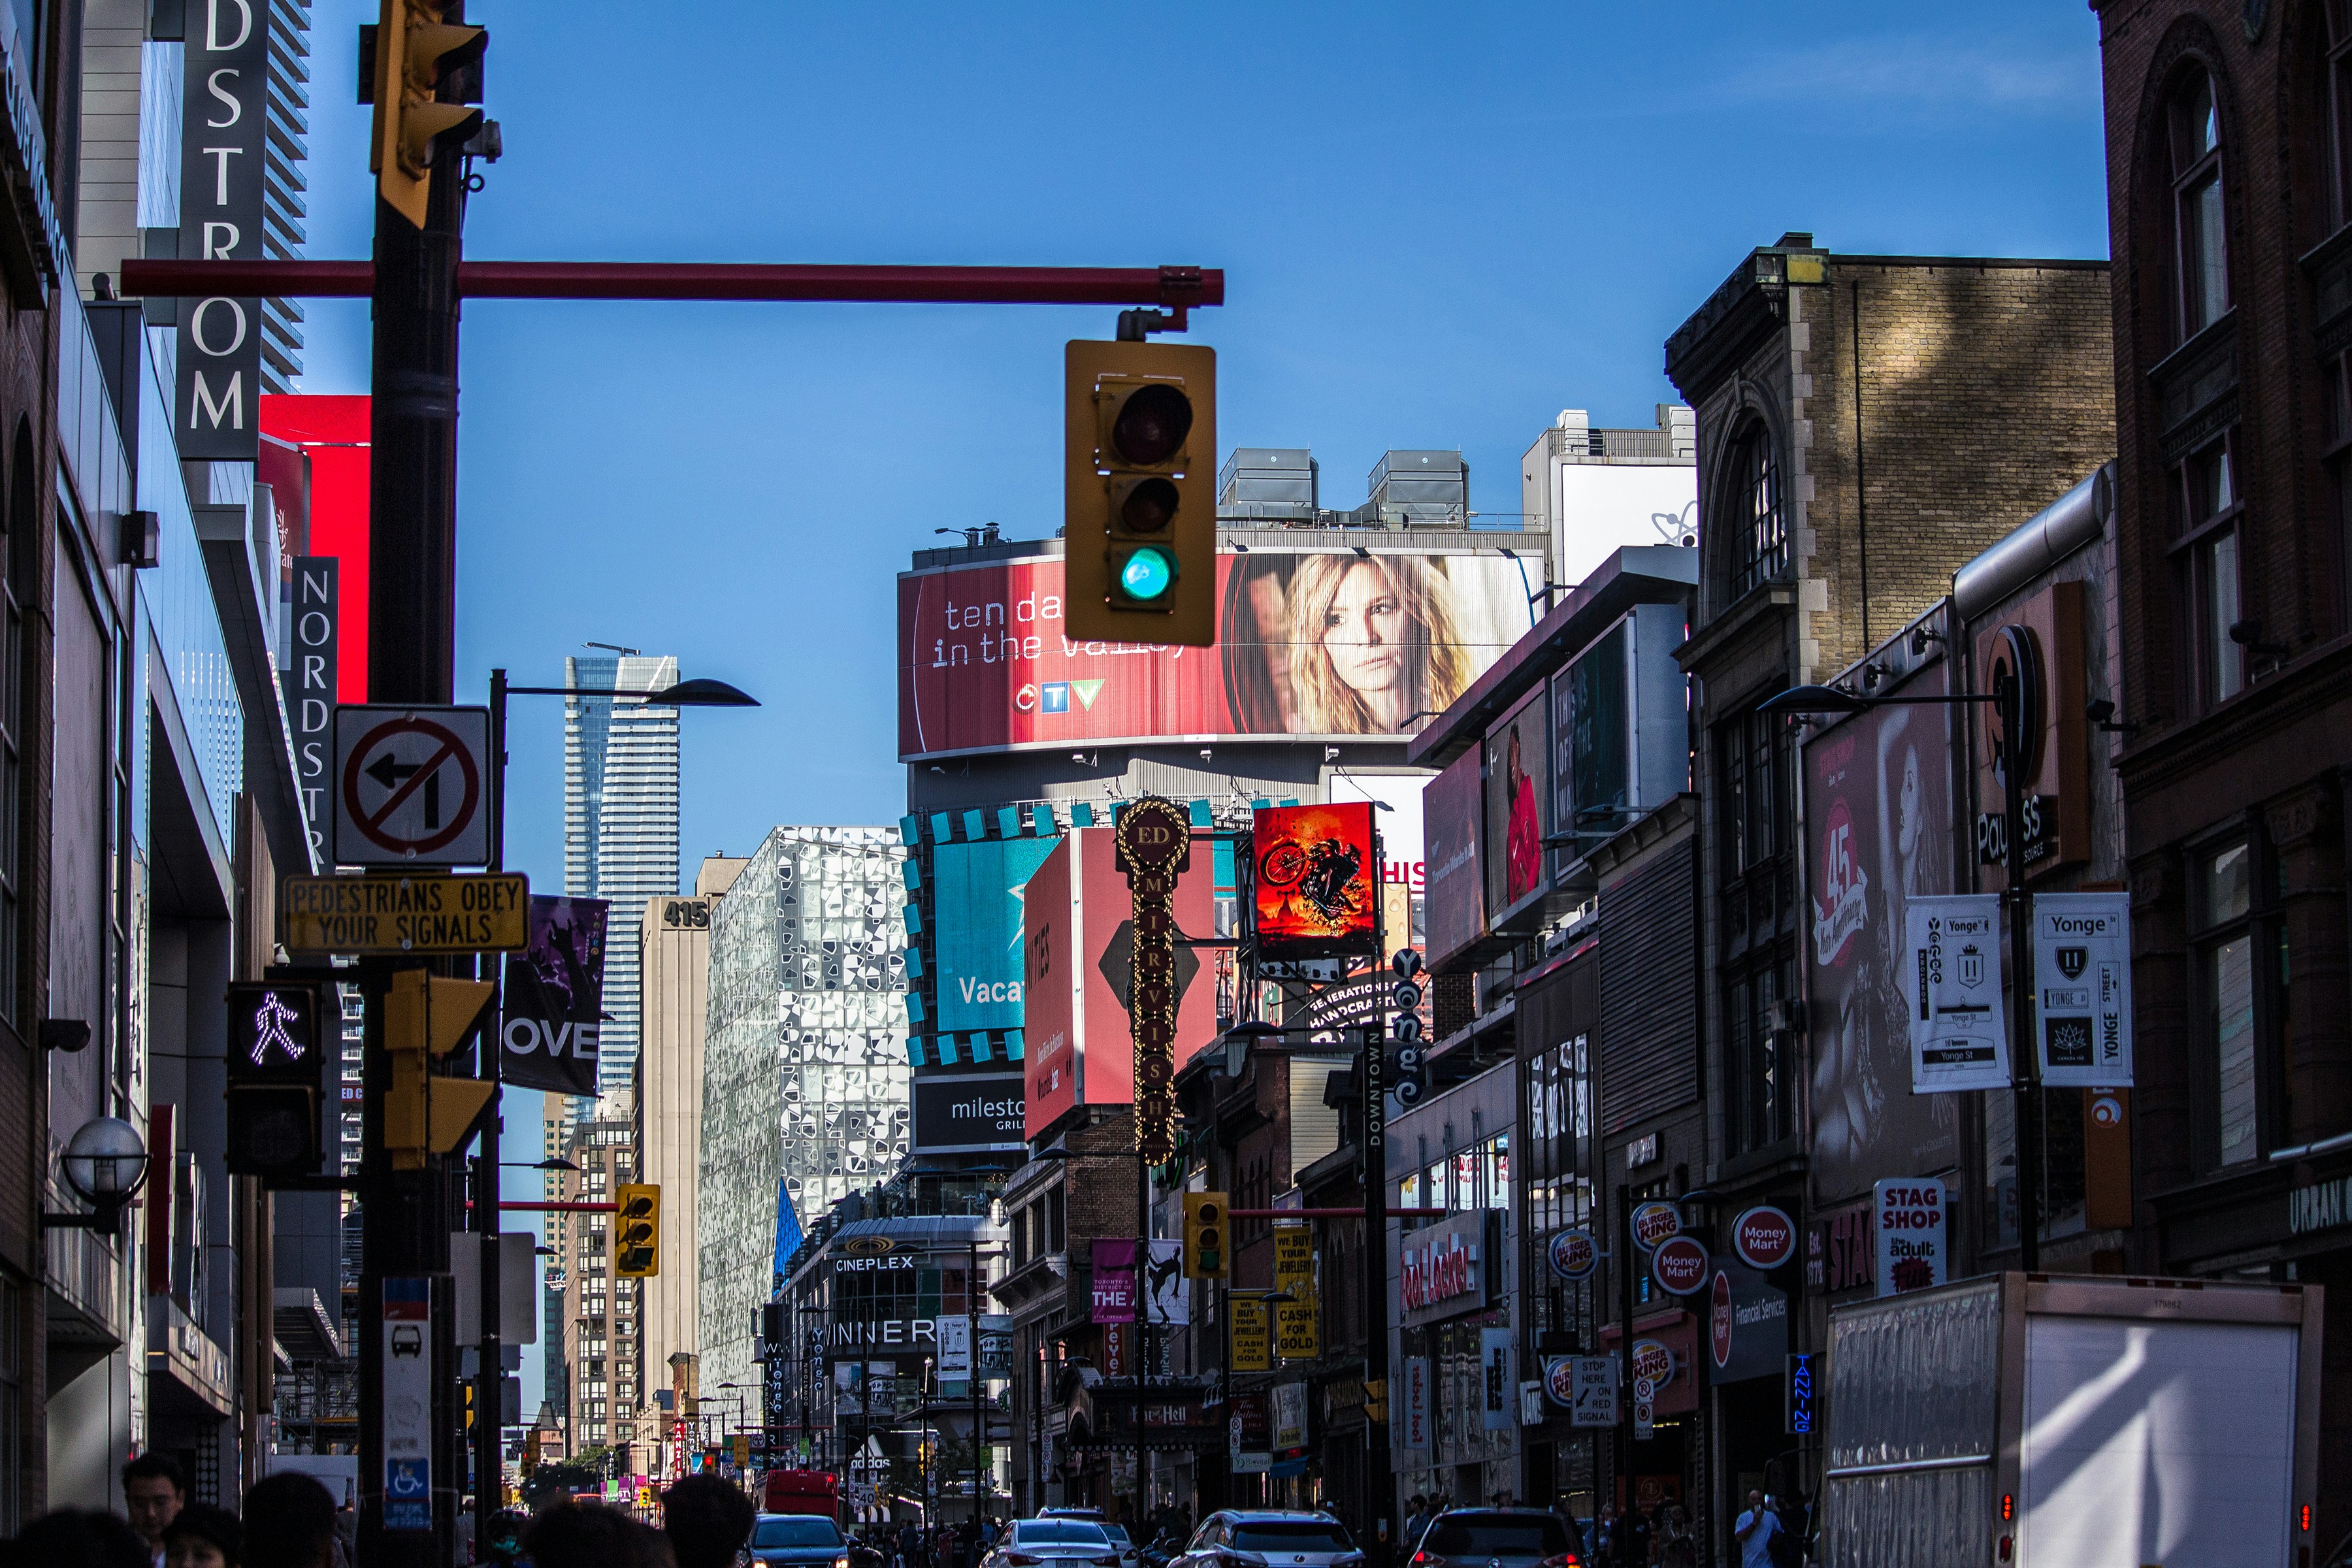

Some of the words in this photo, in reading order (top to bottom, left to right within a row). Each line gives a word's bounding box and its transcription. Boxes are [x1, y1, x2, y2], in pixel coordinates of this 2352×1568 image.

[945, 601, 1005, 630] ten
[933, 638, 968, 668] in
[980, 632, 1041, 663] the
[1016, 683, 1100, 712] CTV
[1137, 826, 1170, 845] ED
[1978, 794, 2041, 868] Payss
[1827, 823, 1850, 909] 45
[293, 883, 442, 914] PEDESTRIANS
[461, 881, 520, 913] OBEY
[664, 901, 709, 927] 415
[318, 917, 378, 945] YOUR
[396, 915, 491, 945] SIGNALS
[1949, 920, 1978, 934] Yonge
[2051, 917, 2106, 936] Yonge
[959, 977, 1021, 1004] Vaca
[2102, 968, 2111, 1002] STREET
[1145, 878, 1163, 1115] MIRVISH
[2051, 992, 2074, 1005] YONGE
[1309, 996, 1397, 1029] HANDCRATE
[1952, 1014, 1968, 1022] Yonge
[1394, 949, 1421, 1106] Yonge
[2104, 1012, 2118, 1060] YONGE
[1941, 1053, 1965, 1062] Yonge
[1369, 1032, 1380, 1146] DOWNTOWN
[1885, 1188, 1938, 1207] STAG
[2289, 1179, 2340, 1234] URBAN
[1638, 1211, 1675, 1230] BURGER
[1882, 1210, 1941, 1230] SHOP
[1639, 1219, 1677, 1241] KING
[1745, 1227, 1786, 1241] Money
[1278, 1237, 1290, 1247] WE
[1292, 1234, 1309, 1247] BUY
[1557, 1239, 1590, 1256] BURGER
[1750, 1237, 1779, 1250] Mart
[1890, 1241, 1935, 1256] adult
[1281, 1249, 1307, 1258] YOUR
[1558, 1247, 1592, 1269] KING
[1662, 1256, 1702, 1270] Money
[836, 1256, 914, 1273] CINEPLEX
[1278, 1259, 1311, 1274] JEWELLERY
[1426, 1233, 1469, 1305] Locker
[1667, 1266, 1695, 1277] Mart
[1400, 1248, 1424, 1312] Foot
[1092, 1291, 1127, 1307] THE
[1237, 1309, 1254, 1318] BUY
[1279, 1309, 1313, 1322] CASH
[1713, 1303, 1729, 1325] Money
[1735, 1302, 1761, 1326] Financial
[1762, 1298, 1786, 1322] Services
[1234, 1326, 1266, 1336] JEWELLERY
[1286, 1324, 1307, 1335] FOR
[1715, 1322, 1727, 1339] Mart
[1280, 1337, 1314, 1350] GOLD
[1582, 1362, 1606, 1371] STOP
[1633, 1350, 1666, 1367] BURGER
[1634, 1358, 1669, 1379] KING
[1582, 1374, 1607, 1384] HERE
[1598, 1388, 1611, 1396] ON
[1795, 1354, 1810, 1433] TANNING
[1592, 1399, 1611, 1409] RED
[1163, 1405, 1186, 1425] Hell
[1578, 1413, 1611, 1422] SIGNAL
[851, 1458, 892, 1470] addas
[860, 1493, 875, 1504] 40
